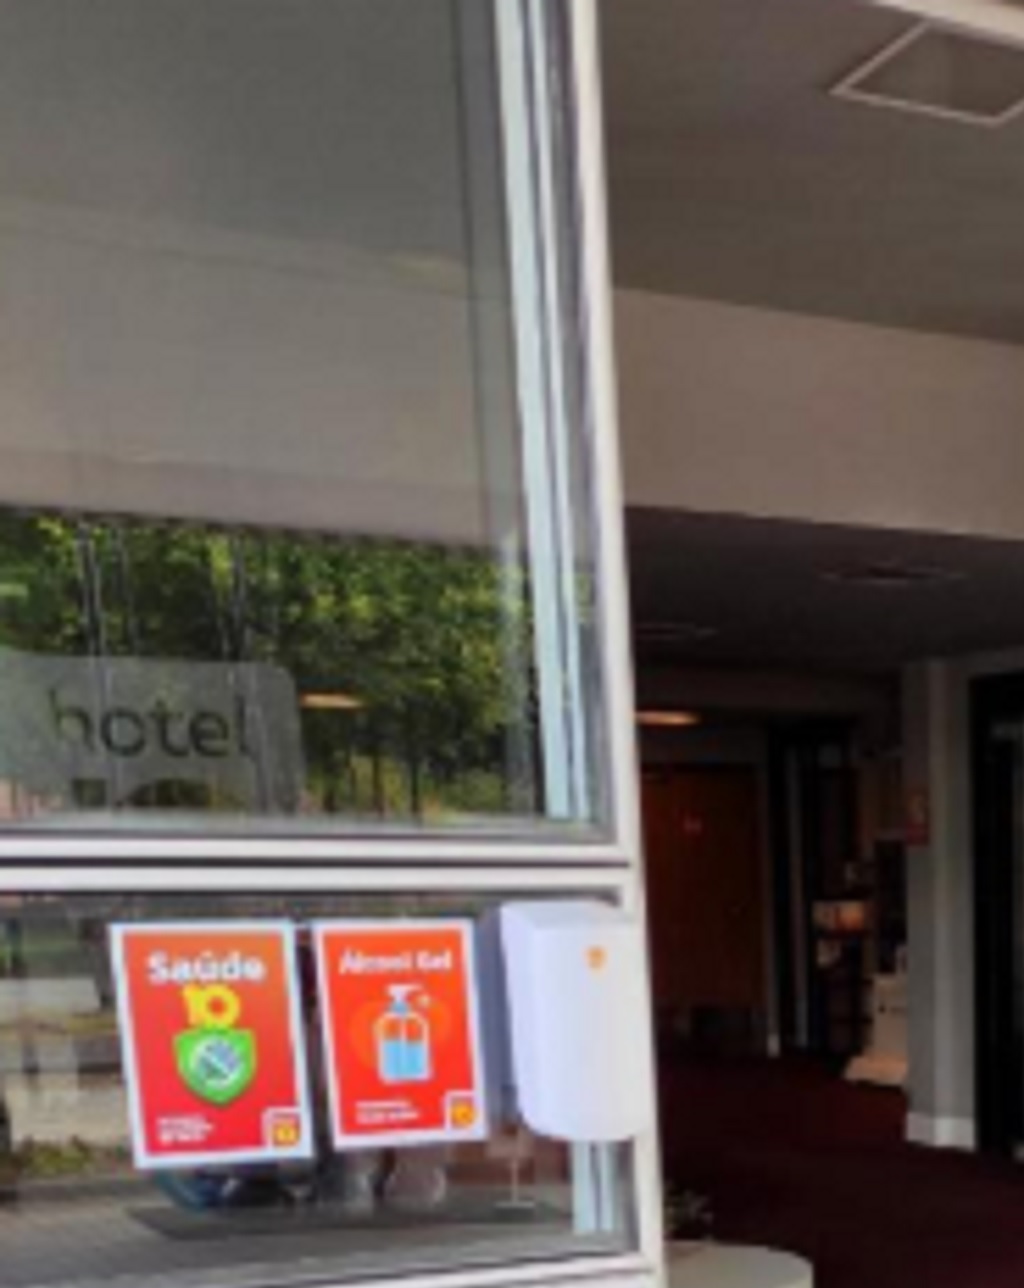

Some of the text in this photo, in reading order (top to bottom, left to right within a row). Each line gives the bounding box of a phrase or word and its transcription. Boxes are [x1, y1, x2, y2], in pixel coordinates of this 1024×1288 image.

[48, 687, 251, 758] hotel
[147, 950, 267, 985] Saúde
[182, 983, 241, 1027] 10
